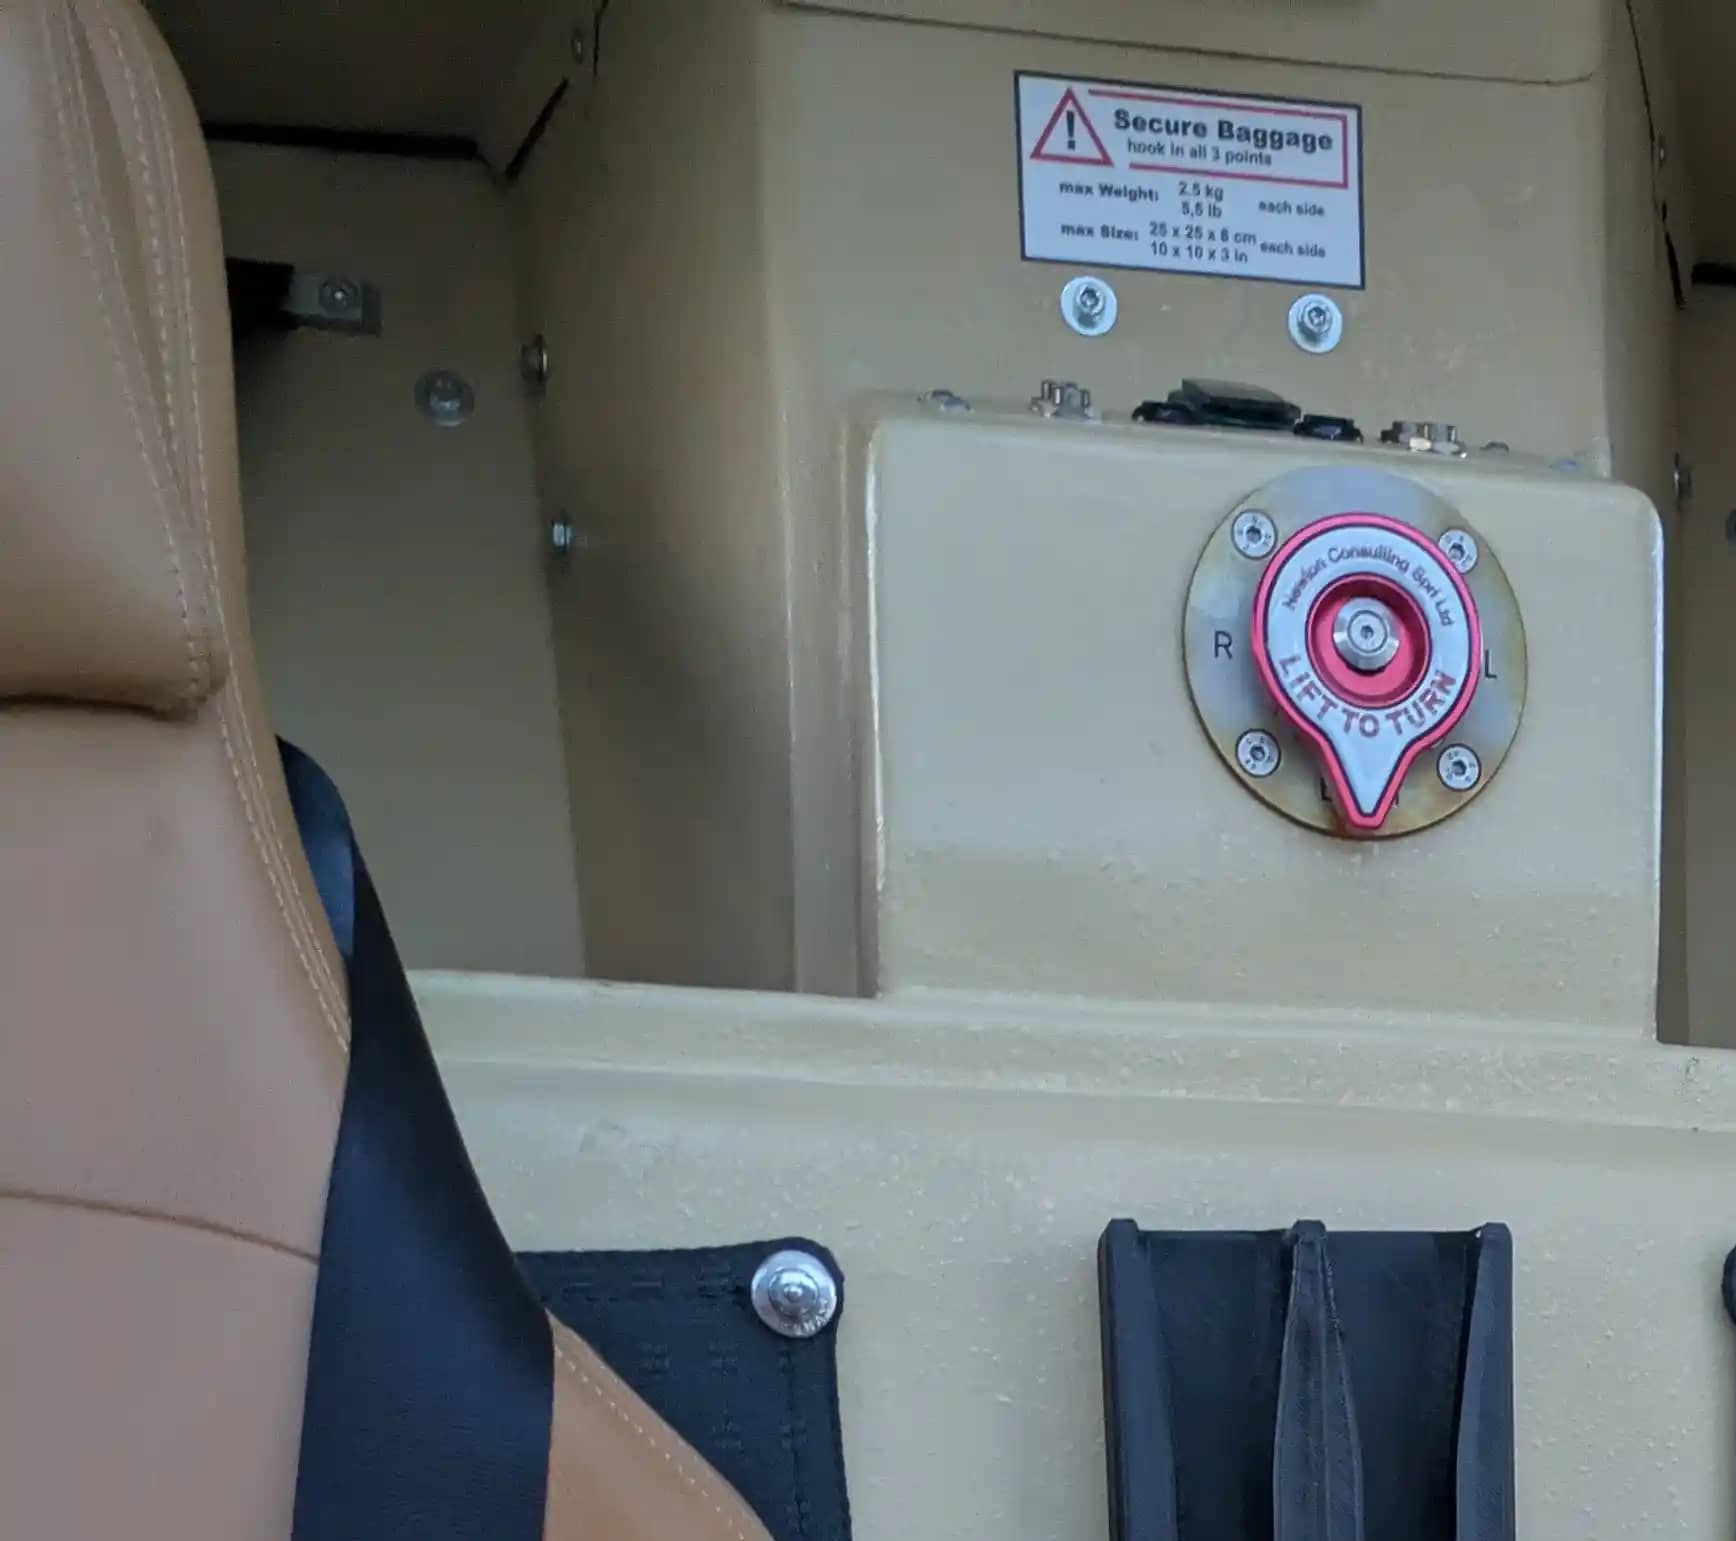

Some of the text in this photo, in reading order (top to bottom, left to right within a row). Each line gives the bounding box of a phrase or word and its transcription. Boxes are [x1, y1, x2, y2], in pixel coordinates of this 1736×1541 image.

[1114, 109, 1333, 153] Secure Baggage
[1127, 138, 1271, 166] hook in all 3 points
[1059, 181, 1093, 196] max
[1100, 182, 1159, 203] Weight:
[1205, 184, 1223, 202] kg
[1208, 203, 1222, 218] lb
[1258, 200, 1324, 217] each side
[1061, 224, 1094, 238] max
[1100, 224, 1139, 241] Size:
[1234, 231, 1256, 245] cm
[1151, 240, 1168, 256] 10
[1188, 244, 1203, 260] 10
[1221, 247, 1229, 262] 3
[1260, 240, 1326, 258] each side
[1328, 547, 1410, 574] Consulting
[1214, 631, 1232, 659] R
[1484, 649, 1497, 678] L
[1280, 656, 1456, 737] LIFT TO TURN
